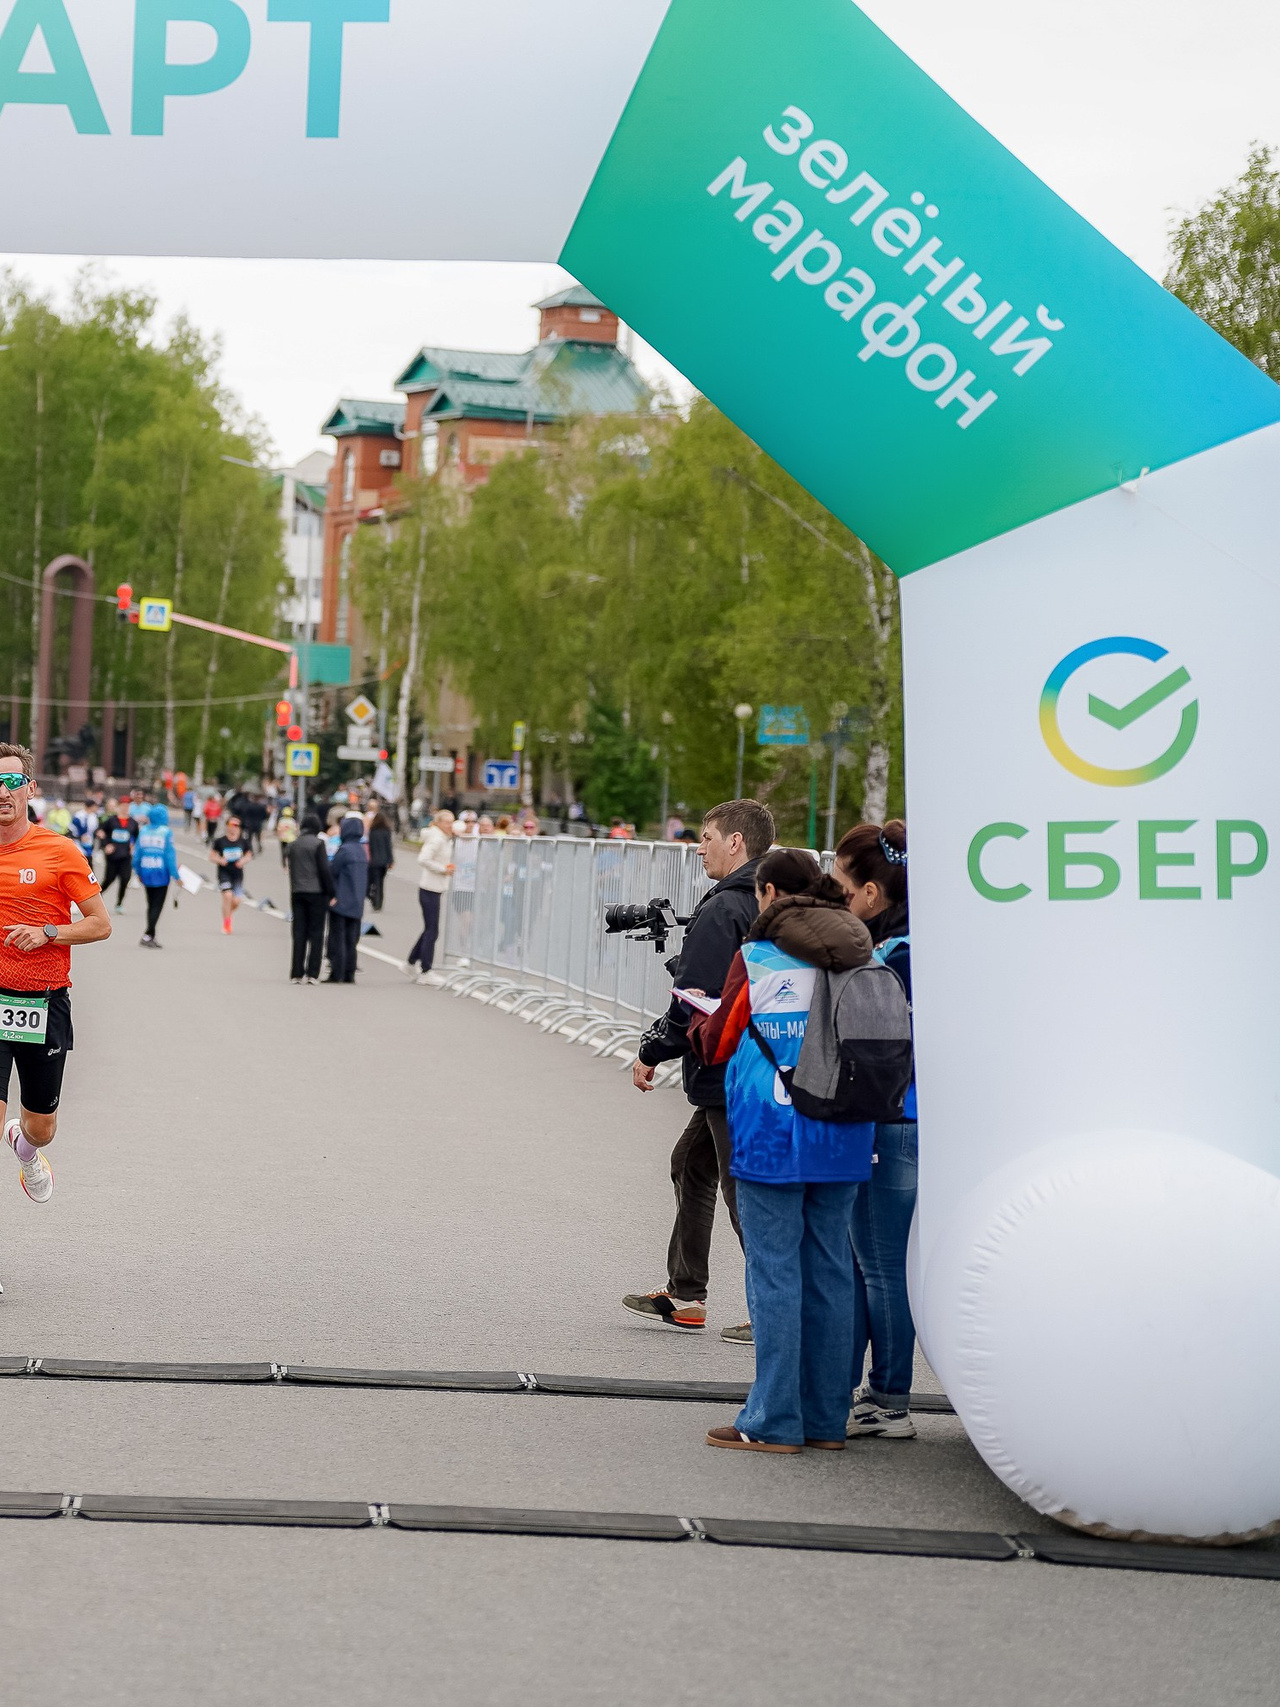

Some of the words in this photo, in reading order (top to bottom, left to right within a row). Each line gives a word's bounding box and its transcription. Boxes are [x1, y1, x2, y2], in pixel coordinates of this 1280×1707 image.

[706, 156, 999, 430] марафон
[762, 105, 1065, 377] зелёный
[967, 819, 1269, 903] СБЕР
